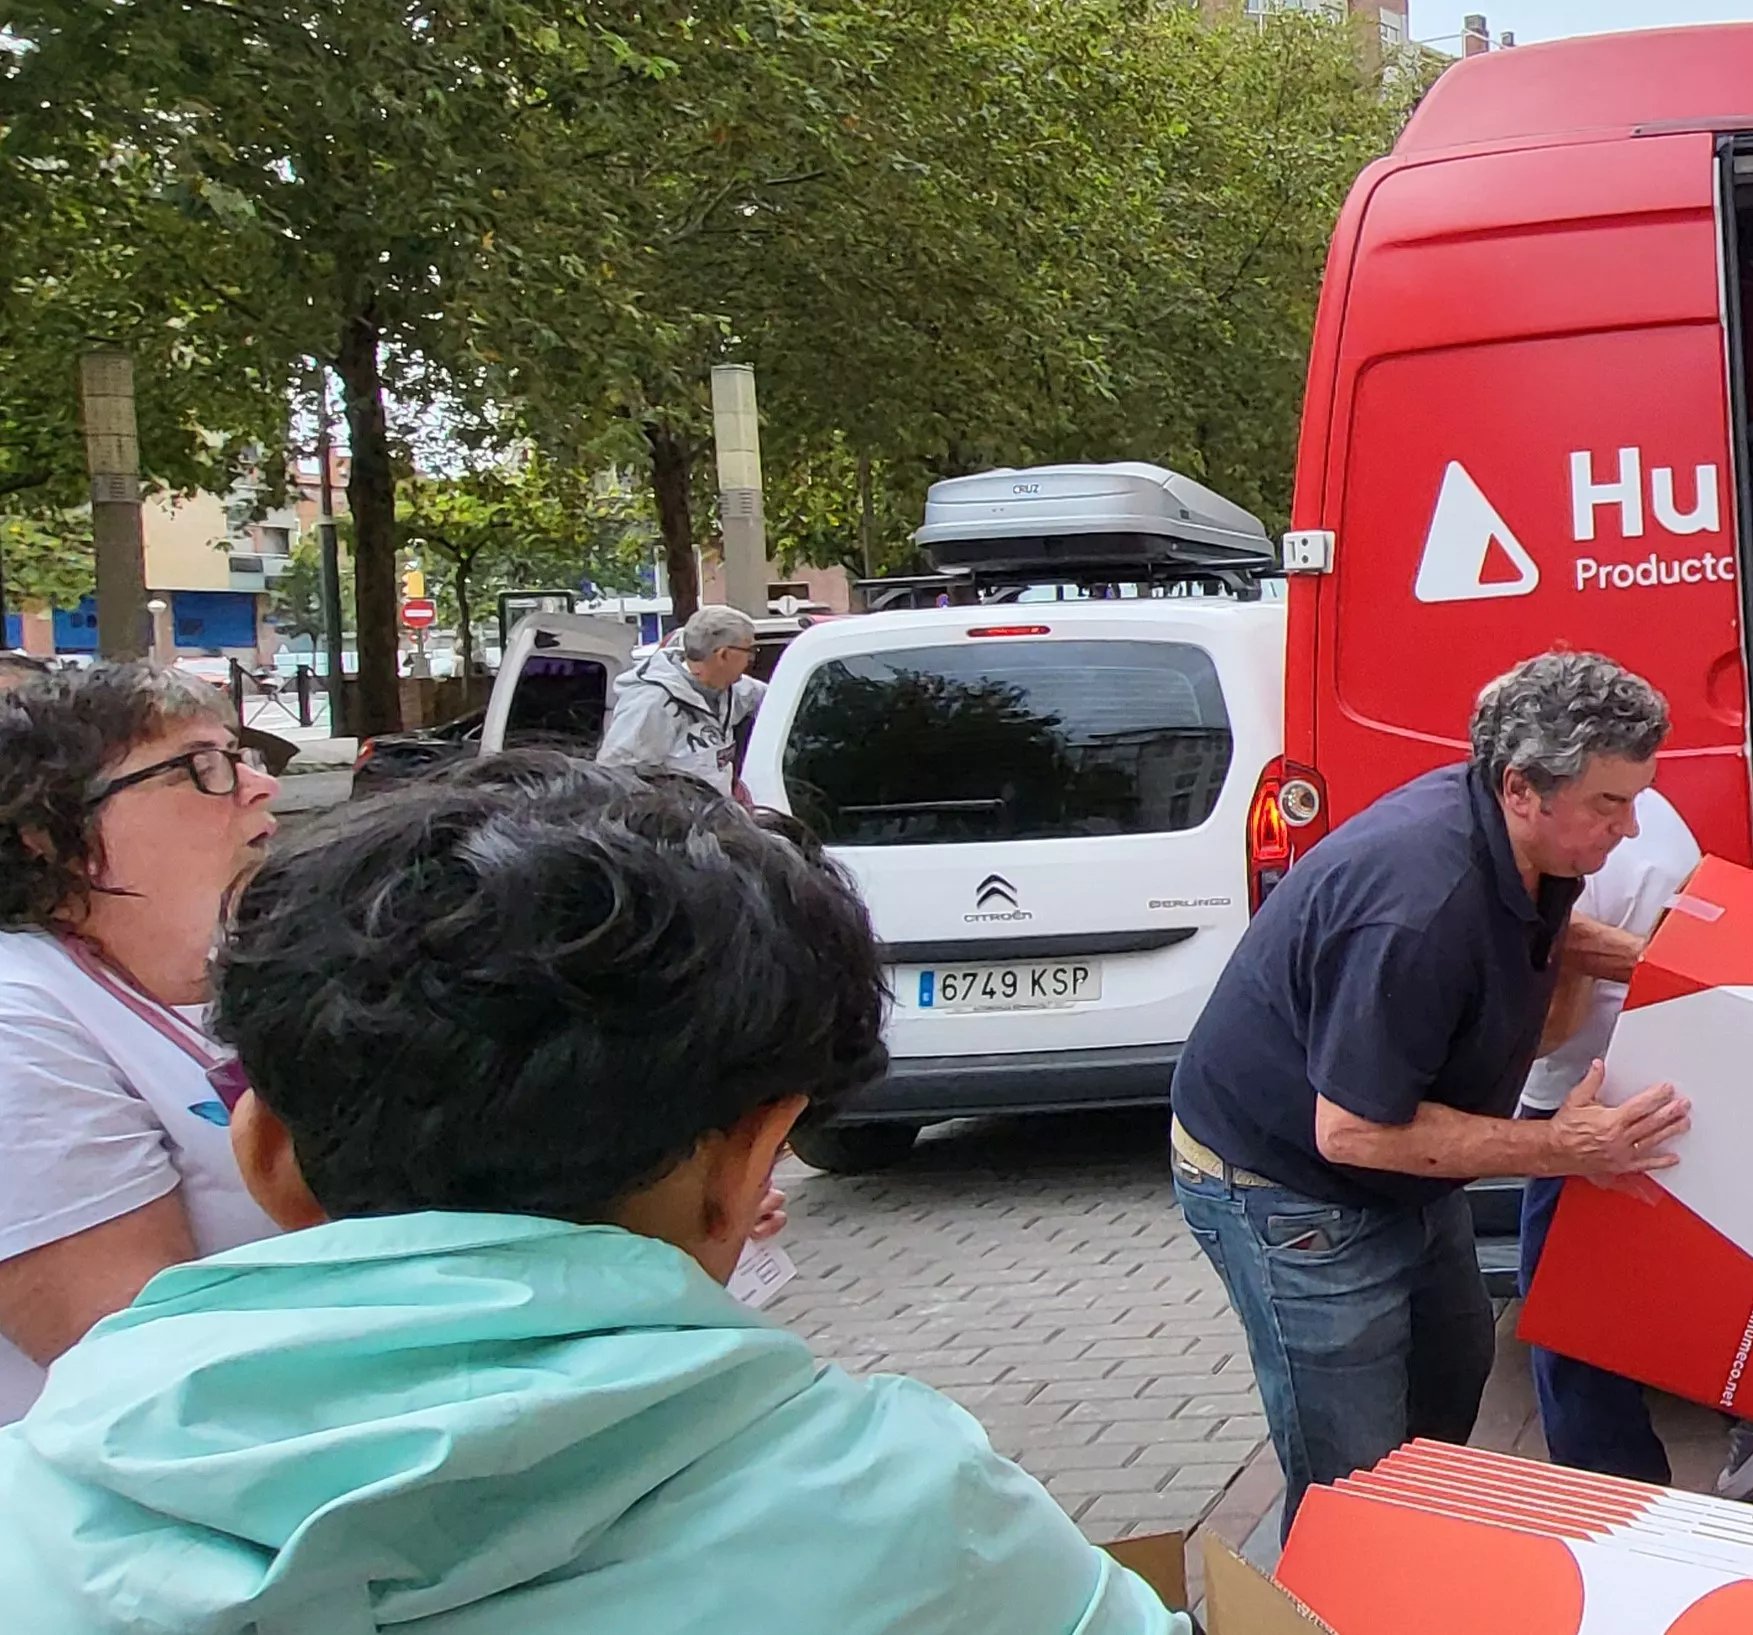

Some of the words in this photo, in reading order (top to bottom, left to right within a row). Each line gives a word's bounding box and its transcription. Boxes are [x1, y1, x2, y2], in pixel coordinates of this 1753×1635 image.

[1012, 484, 1041, 495] CRUZ
[1570, 446, 1720, 541] Hu
[1148, 897, 1231, 909] BERLINGO
[942, 971, 1018, 1000] 6749
[1031, 967, 1089, 997] KSP
